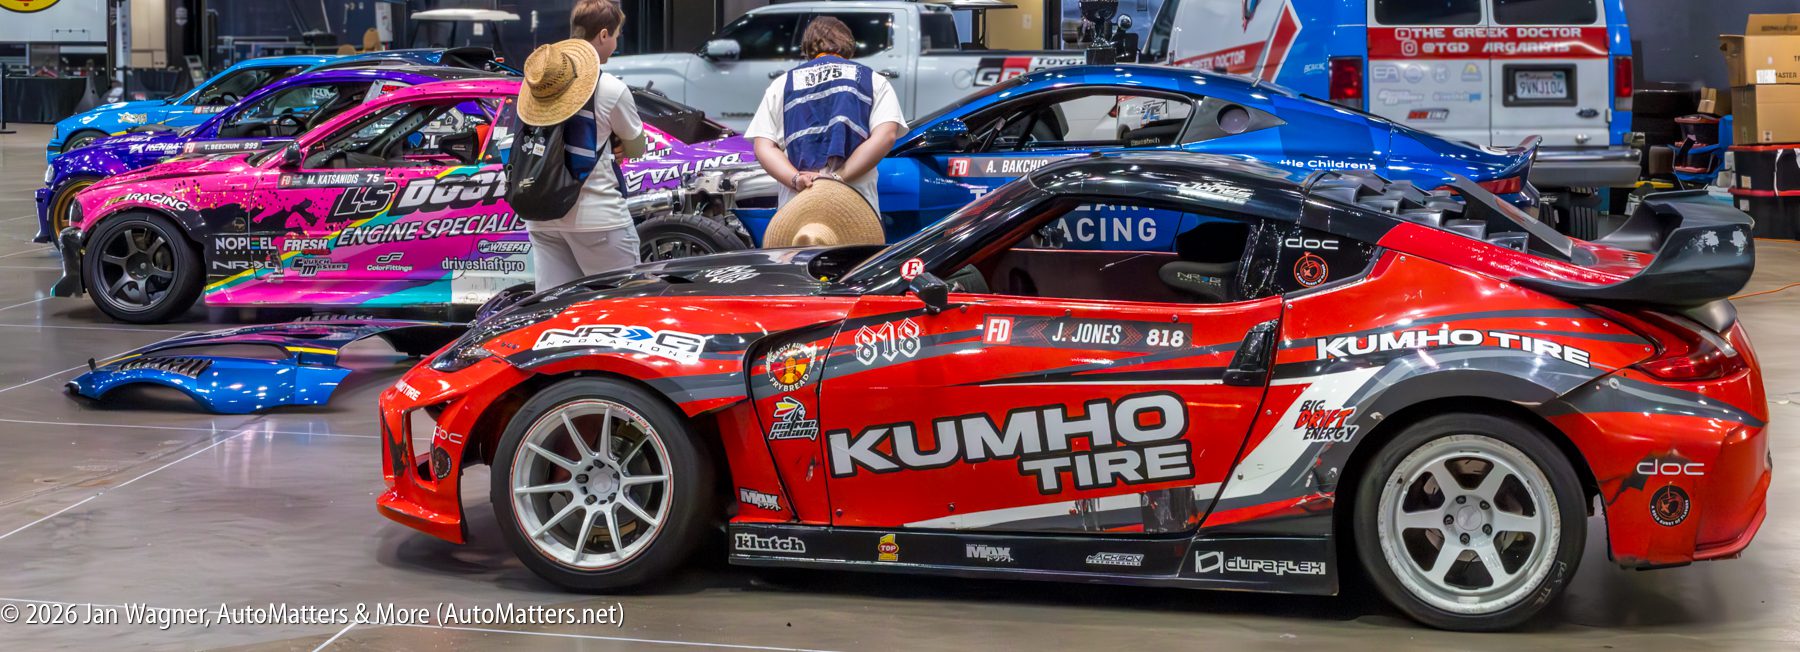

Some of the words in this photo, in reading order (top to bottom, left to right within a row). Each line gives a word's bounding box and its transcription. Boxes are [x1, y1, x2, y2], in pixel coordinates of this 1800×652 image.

[1411, 28, 1446, 38] THE
[1453, 28, 1509, 38] GREEK
[1517, 28, 1582, 38] DOCTOR
[951, 160, 968, 174] FD
[986, 160, 997, 173] A.
[1307, 160, 1377, 170] Children's
[366, 173, 380, 183] 75
[337, 220, 419, 246] ENGINE
[1056, 217, 1157, 242] ACING
[284, 238, 329, 251] FRESH
[1285, 236, 1339, 250] doc
[367, 263, 413, 272] ColorFittings
[441, 255, 526, 274] driveshaftpro
[854, 317, 921, 366] 818
[986, 318, 1011, 342] FD
[1052, 322, 1066, 342] J.
[1071, 322, 1122, 345] JONES
[1146, 329, 1184, 347] 818
[1317, 329, 1482, 360] KUMHO
[1490, 332, 1591, 368] TIRE
[769, 373, 810, 392] FRYBREAD
[1299, 399, 1326, 412] BIG
[1293, 408, 1356, 430] DRIFT
[828, 393, 1186, 478] KUMHO
[1302, 427, 1359, 441] ENERGY
[1022, 443, 1192, 490] TIRE
[1636, 458, 1705, 476] doc
[880, 544, 897, 552] TOP
